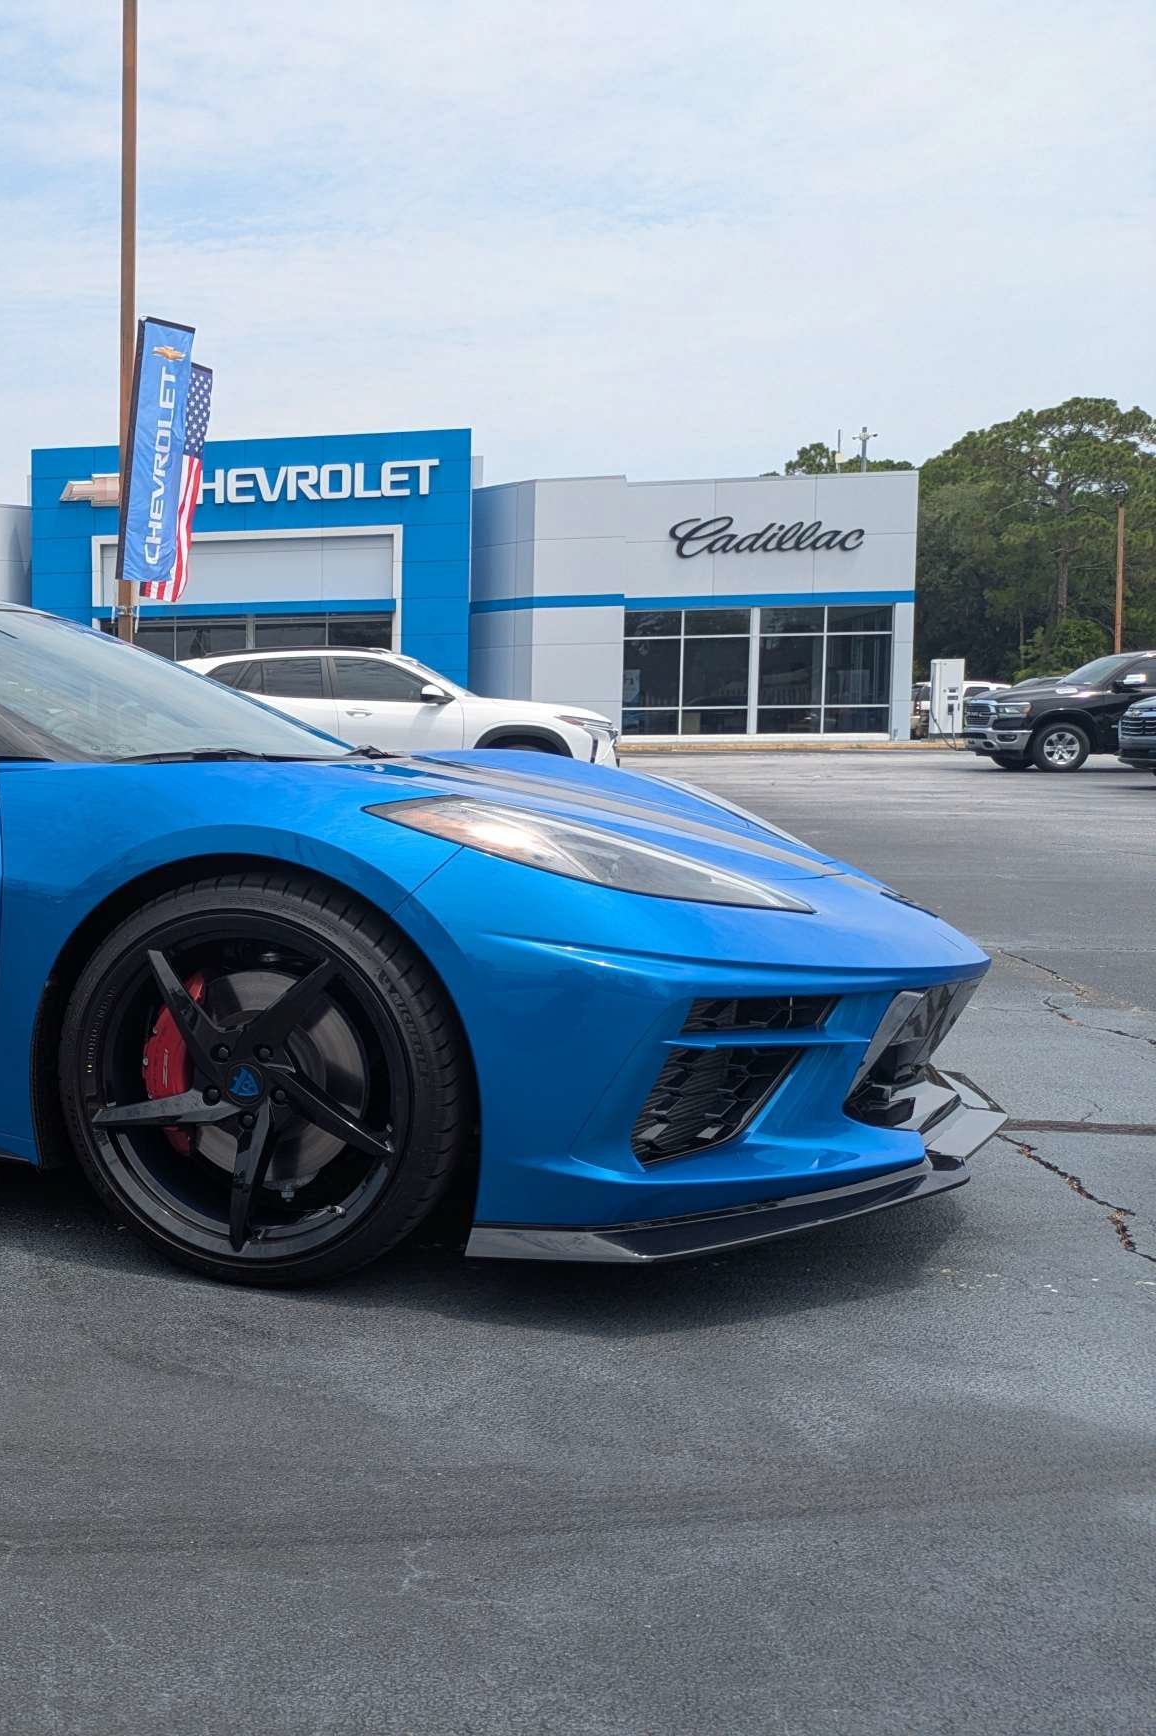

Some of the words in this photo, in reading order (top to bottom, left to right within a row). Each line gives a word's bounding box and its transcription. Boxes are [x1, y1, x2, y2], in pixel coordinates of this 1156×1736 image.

[144, 366, 177, 565] CHEVROLET
[194, 458, 440, 505] HEVROLET
[668, 516, 865, 559] Cadillac
